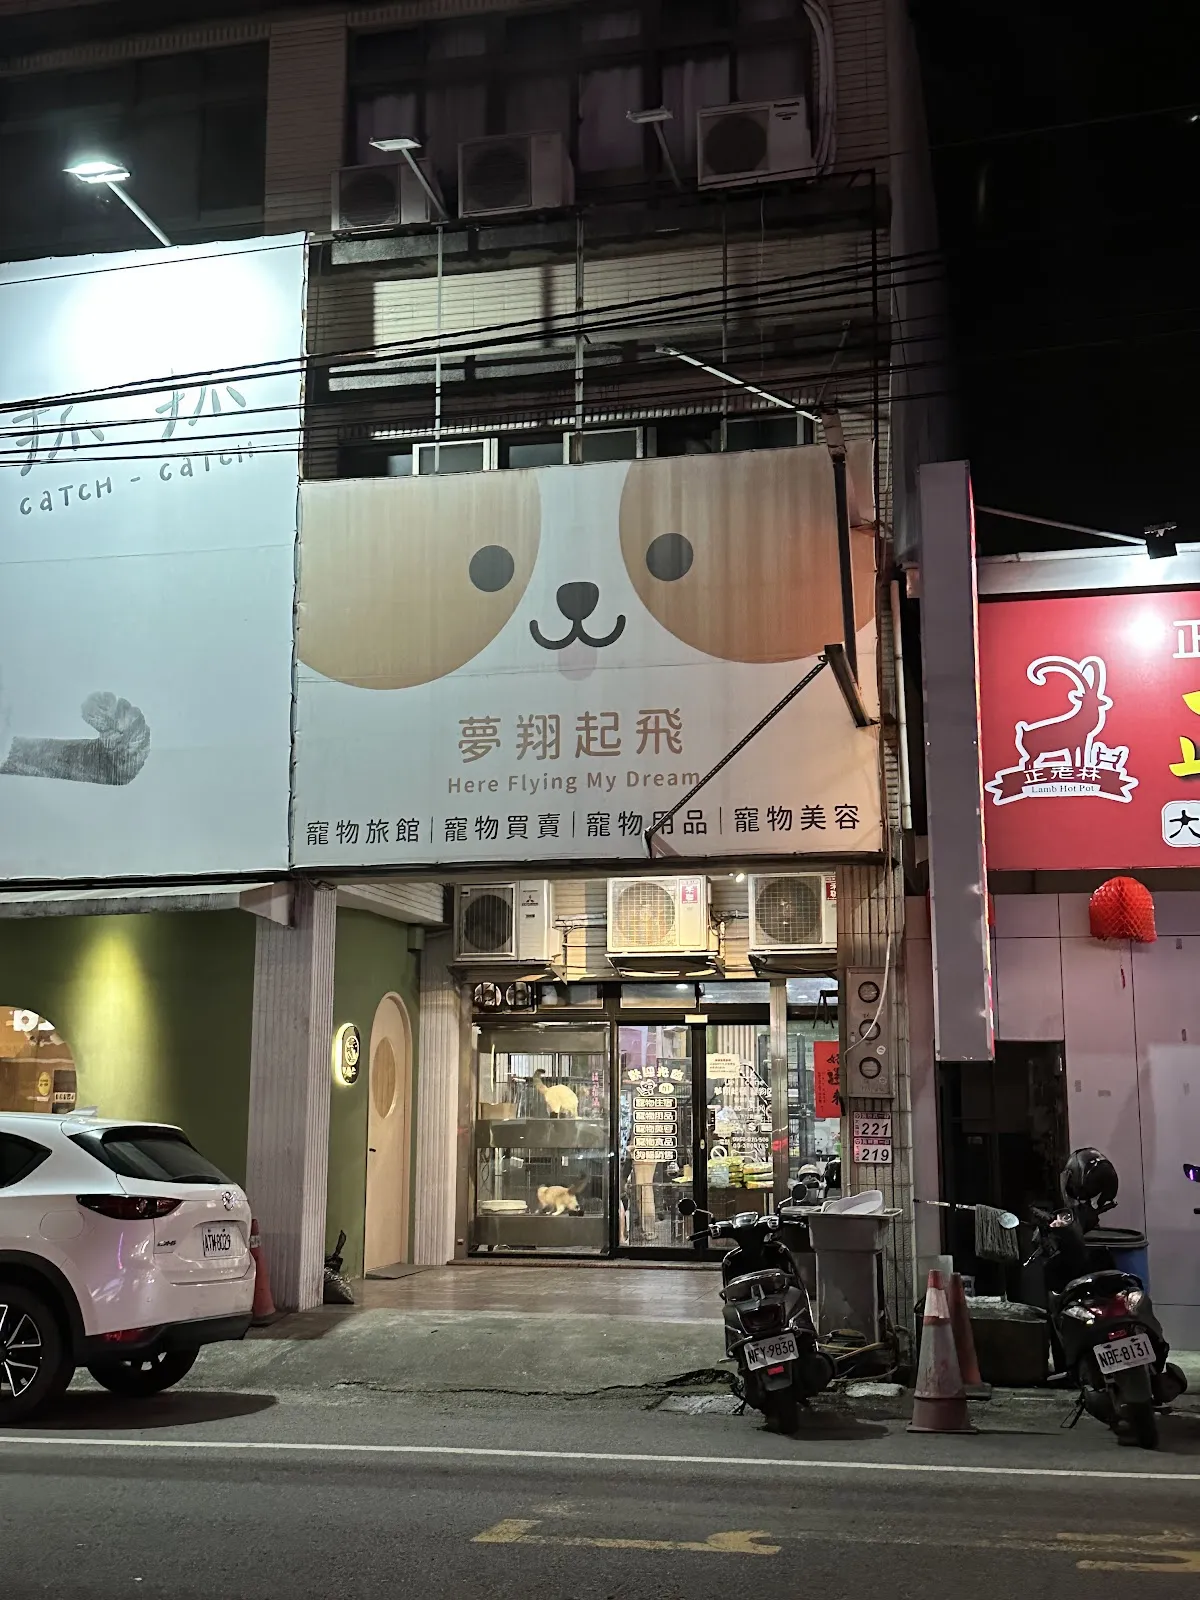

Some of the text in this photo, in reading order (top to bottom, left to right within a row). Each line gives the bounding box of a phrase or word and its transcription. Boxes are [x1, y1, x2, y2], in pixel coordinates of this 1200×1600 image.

[458, 708, 683, 764] 夢翔起飛
[448, 769, 701, 795] Here Flying My Dream
[1031, 784, 1095, 793] Lamb Hot Pot
[306, 803, 860, 846] 寵物旅館 寵物買賣 寵物用品 寵物美容
[861, 1122, 889, 1135] 221
[861, 1148, 889, 1161] 219
[747, 1340, 795, 1364] NFY-9838
[1098, 1341, 1150, 1368] NBE-8131
